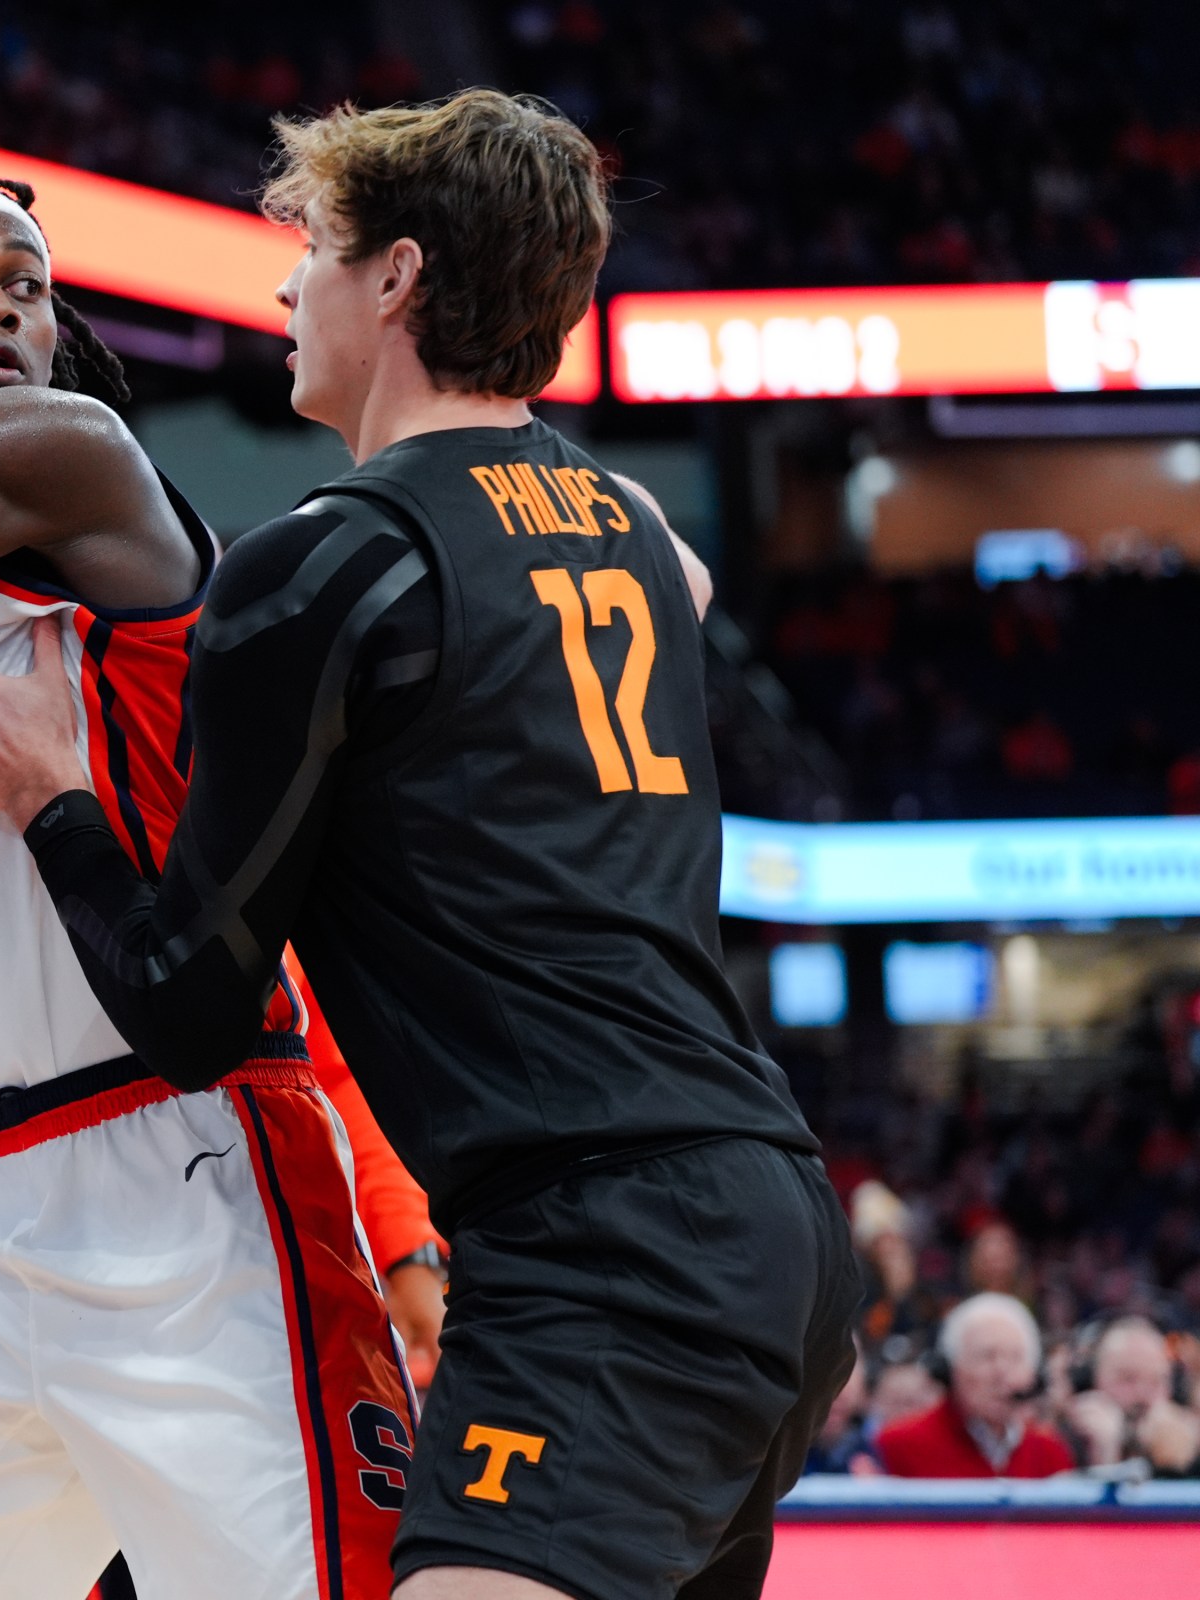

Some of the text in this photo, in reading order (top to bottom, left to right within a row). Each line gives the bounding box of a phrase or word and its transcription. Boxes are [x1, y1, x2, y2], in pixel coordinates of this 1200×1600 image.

[469, 463, 630, 536] PHILLIPS
[530, 568, 689, 794] 12
[347, 1400, 413, 1512] S
[463, 1422, 546, 1504] T
